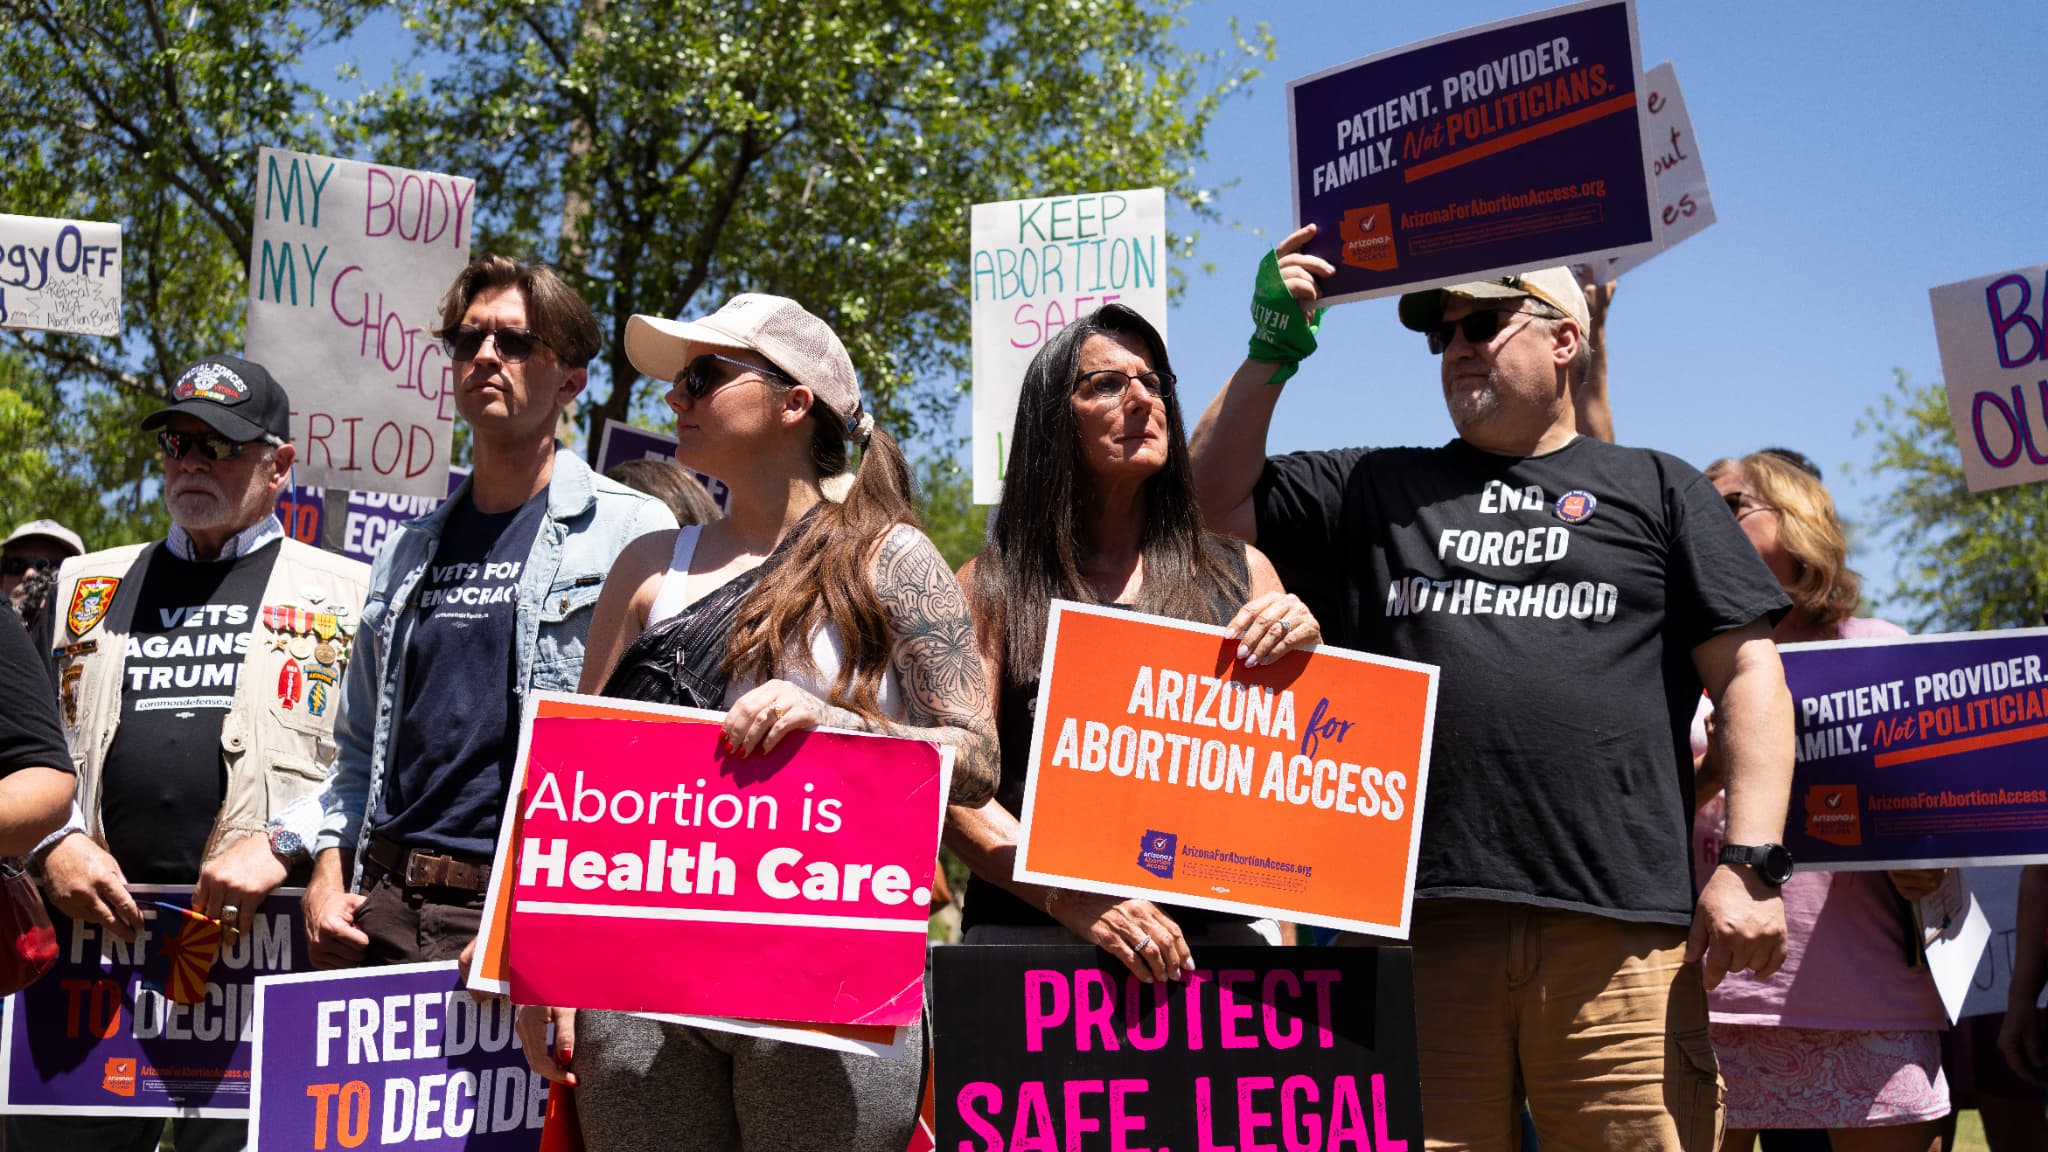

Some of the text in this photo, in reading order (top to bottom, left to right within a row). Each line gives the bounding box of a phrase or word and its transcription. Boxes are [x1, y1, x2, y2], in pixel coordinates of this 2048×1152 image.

[1336, 36, 1578, 150] PATIENT. PROVIDER.
[1313, 63, 1615, 197] FAMILY. Not POLITICIANS.
[265, 155, 476, 249] MY BODY
[1018, 195, 1127, 244] KEEP
[1401, 179, 1606, 231] ArizonaForAbortionAccess.org
[56, 225, 117, 277] OFF
[974, 236, 1156, 301] ABORTION
[259, 239, 456, 421] MY CHOICE
[212, 363, 249, 392] FORCES
[289, 411, 435, 479] RIOD
[279, 501, 320, 545] TO
[1479, 479, 1544, 514] END
[432, 563, 479, 583] VETS
[1438, 526, 1570, 566] FORCED
[159, 604, 249, 628] VETS
[1385, 576, 1618, 623] MOTHERHOOD
[127, 632, 253, 658] AGAINS
[1126, 665, 1355, 759] ARIZONA for
[1802, 654, 2048, 727] PATIENT. PROVIDER.
[1051, 717, 1407, 821] ABORTION ACCESS
[1795, 722, 1867, 763] AMILY.
[1873, 715, 1918, 748] Not
[524, 770, 843, 833] Abortion is
[519, 837, 931, 907] Health Care.
[1182, 844, 1312, 877] ArizonaForAbortionAccess.org
[60, 979, 122, 1039] TO
[1024, 968, 1343, 1052] PROTECT
[306, 1079, 371, 1150] TO
[380, 1066, 550, 1145] DECIDE
[1195, 1073, 1408, 1152] LEGAL
